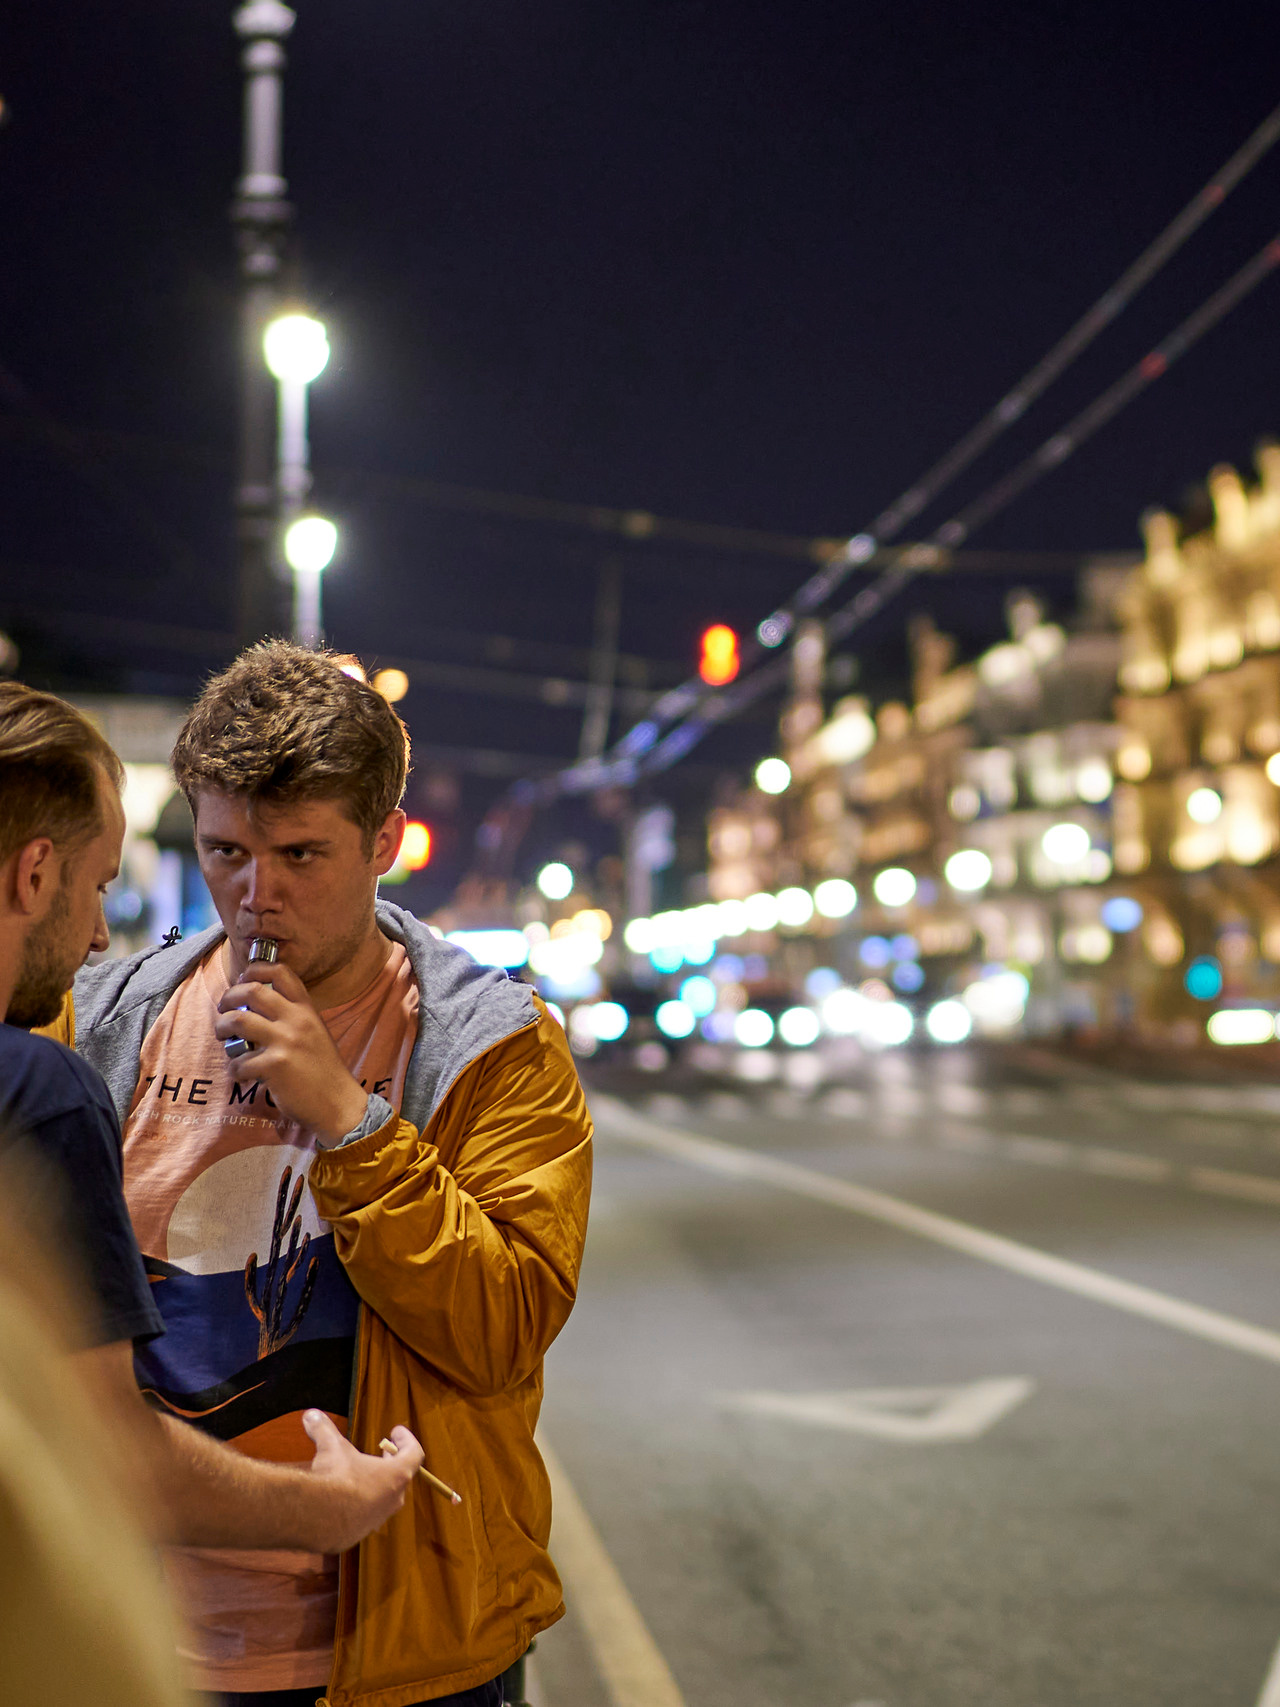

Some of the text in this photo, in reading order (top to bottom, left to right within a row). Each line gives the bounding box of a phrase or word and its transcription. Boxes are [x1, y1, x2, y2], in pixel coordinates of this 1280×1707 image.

[145, 1073, 213, 1106] THE
[162, 1113, 200, 1126] ROCK
[204, 1115, 256, 1128] NATURE
